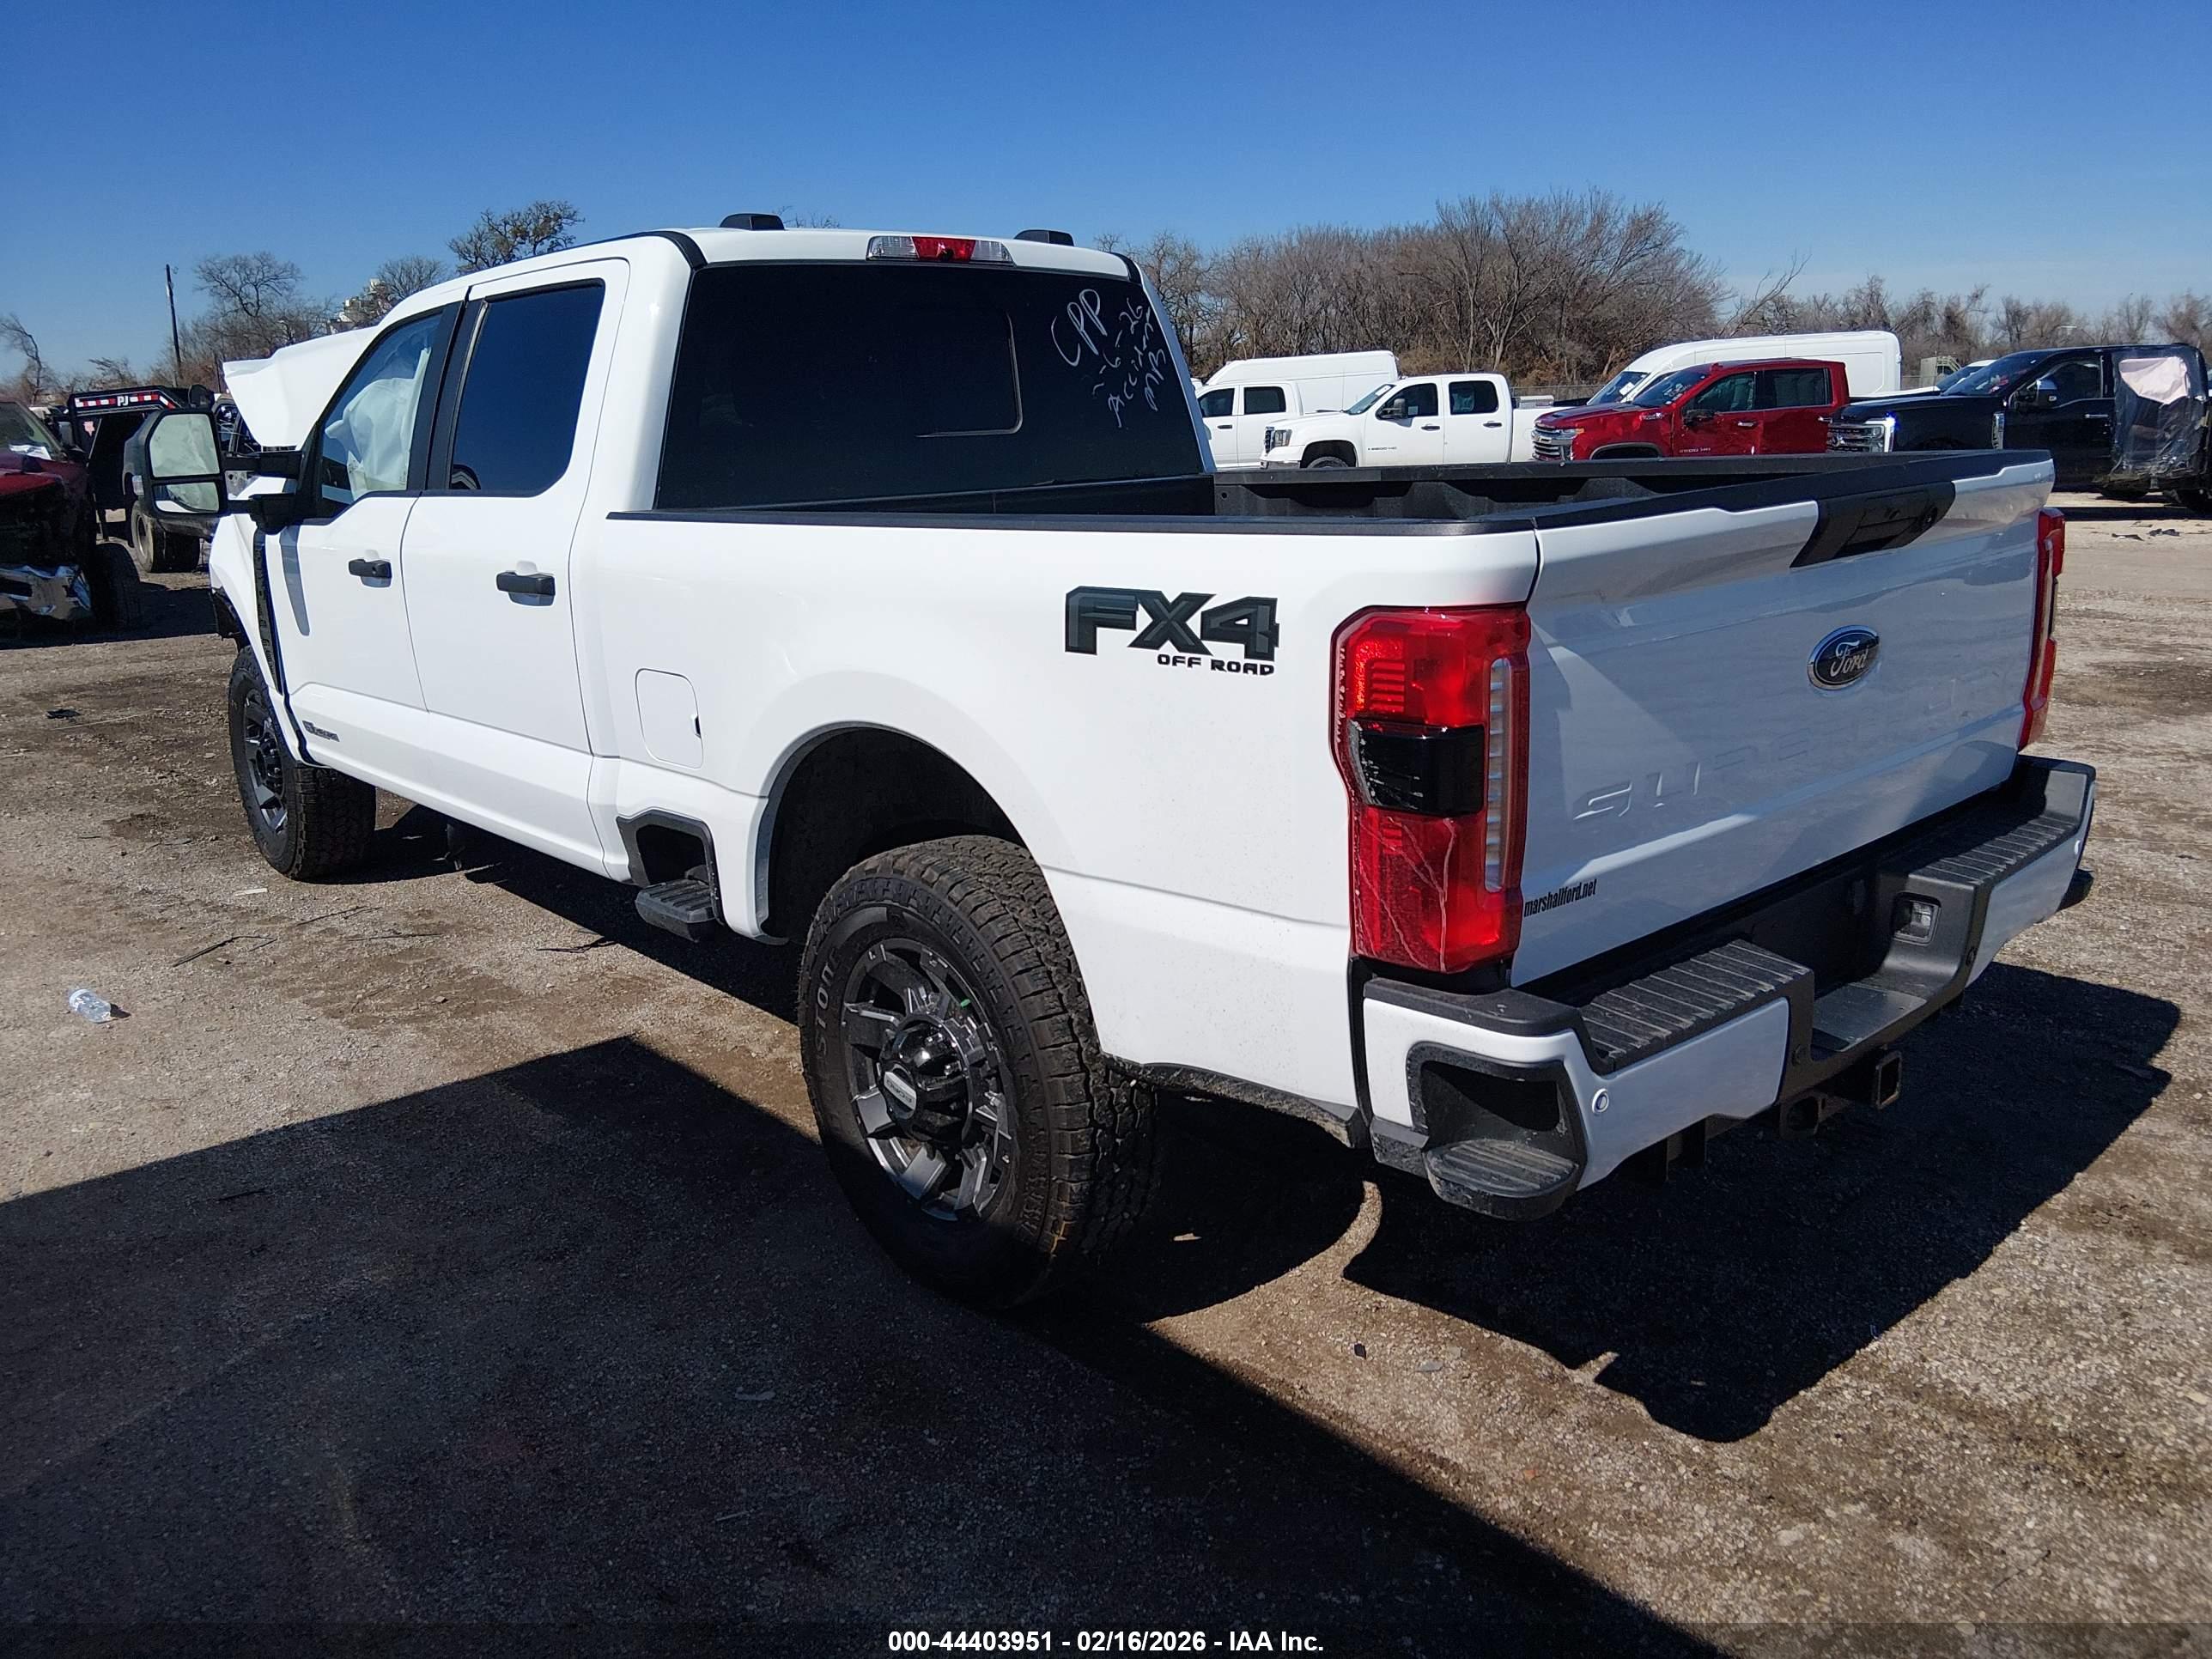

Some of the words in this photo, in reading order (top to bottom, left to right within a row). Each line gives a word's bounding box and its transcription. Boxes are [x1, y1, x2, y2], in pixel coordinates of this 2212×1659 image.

[117, 395, 129, 406] PJ
[1065, 586, 1279, 661] FX4
[1157, 653, 1202, 669] OFF
[1210, 659, 1275, 677] ROAD
[1829, 640, 1870, 677] Ford
[1523, 878, 1597, 918] marshallford.net
